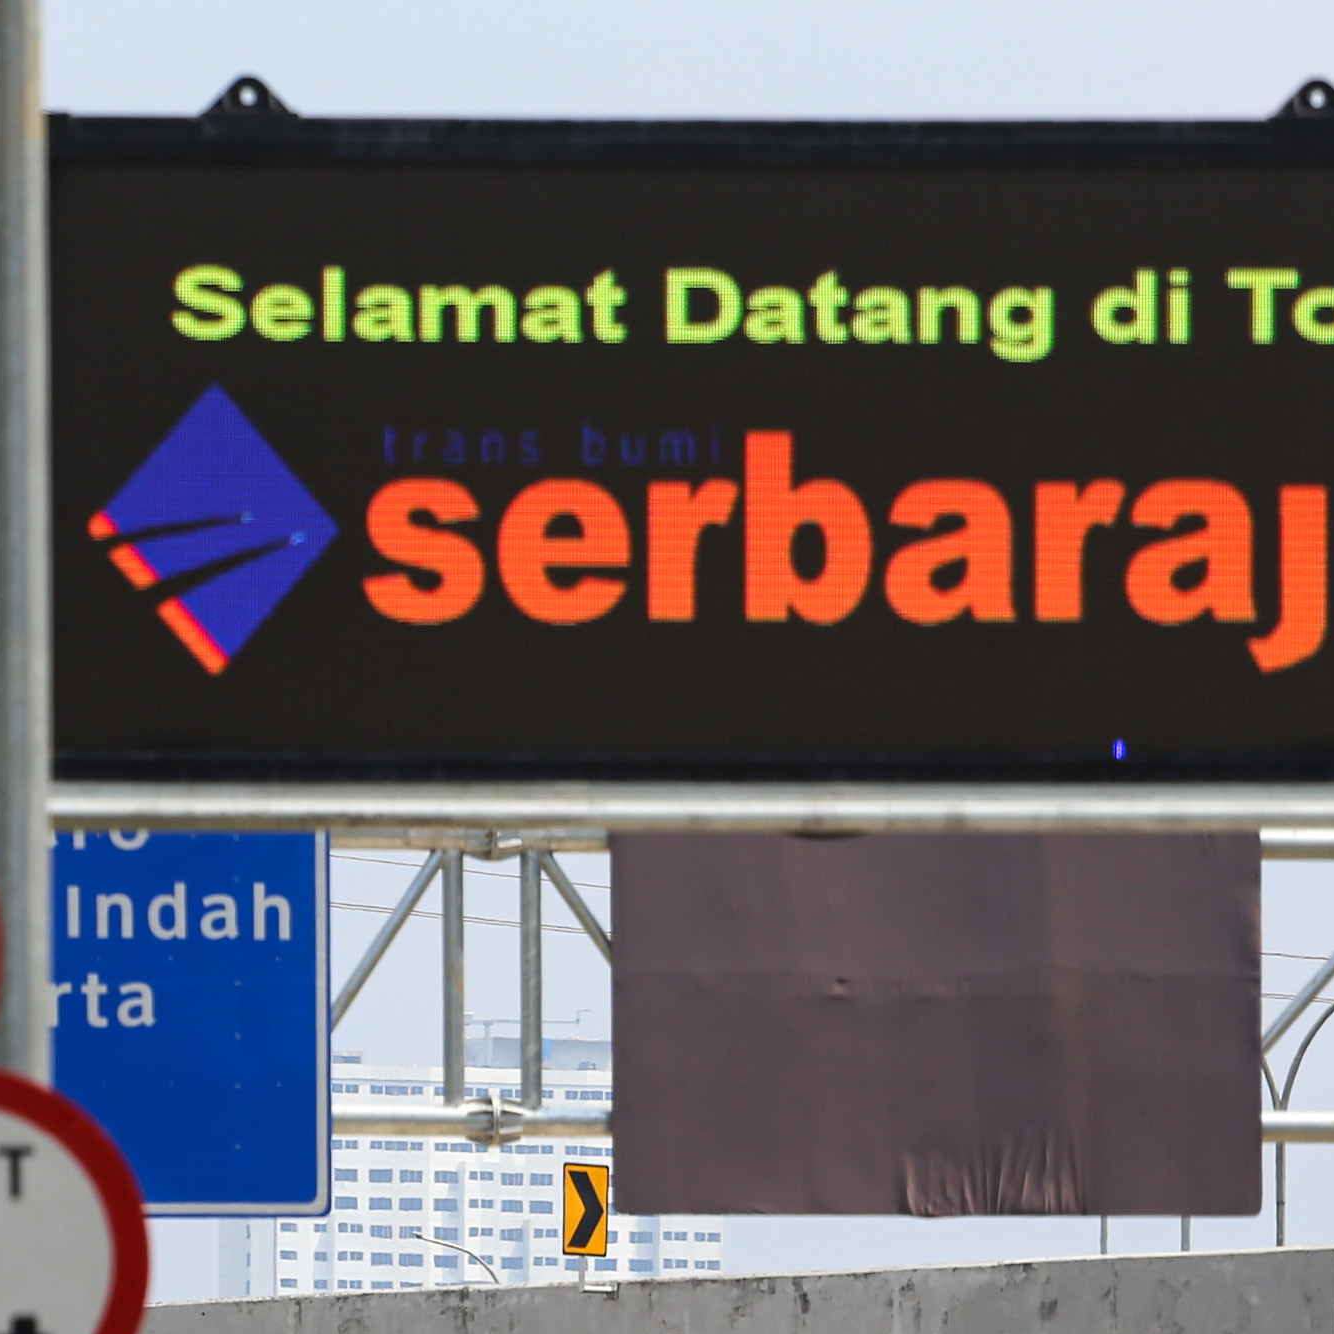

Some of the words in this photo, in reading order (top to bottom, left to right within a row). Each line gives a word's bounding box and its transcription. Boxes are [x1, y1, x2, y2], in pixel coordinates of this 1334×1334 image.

[172, 265, 627, 343] Selamat
[666, 267, 1055, 363] Datang
[1092, 268, 1190, 345] di
[382, 422, 543, 467] trans
[580, 420, 722, 468] bumi
[67, 882, 291, 941] Indah
